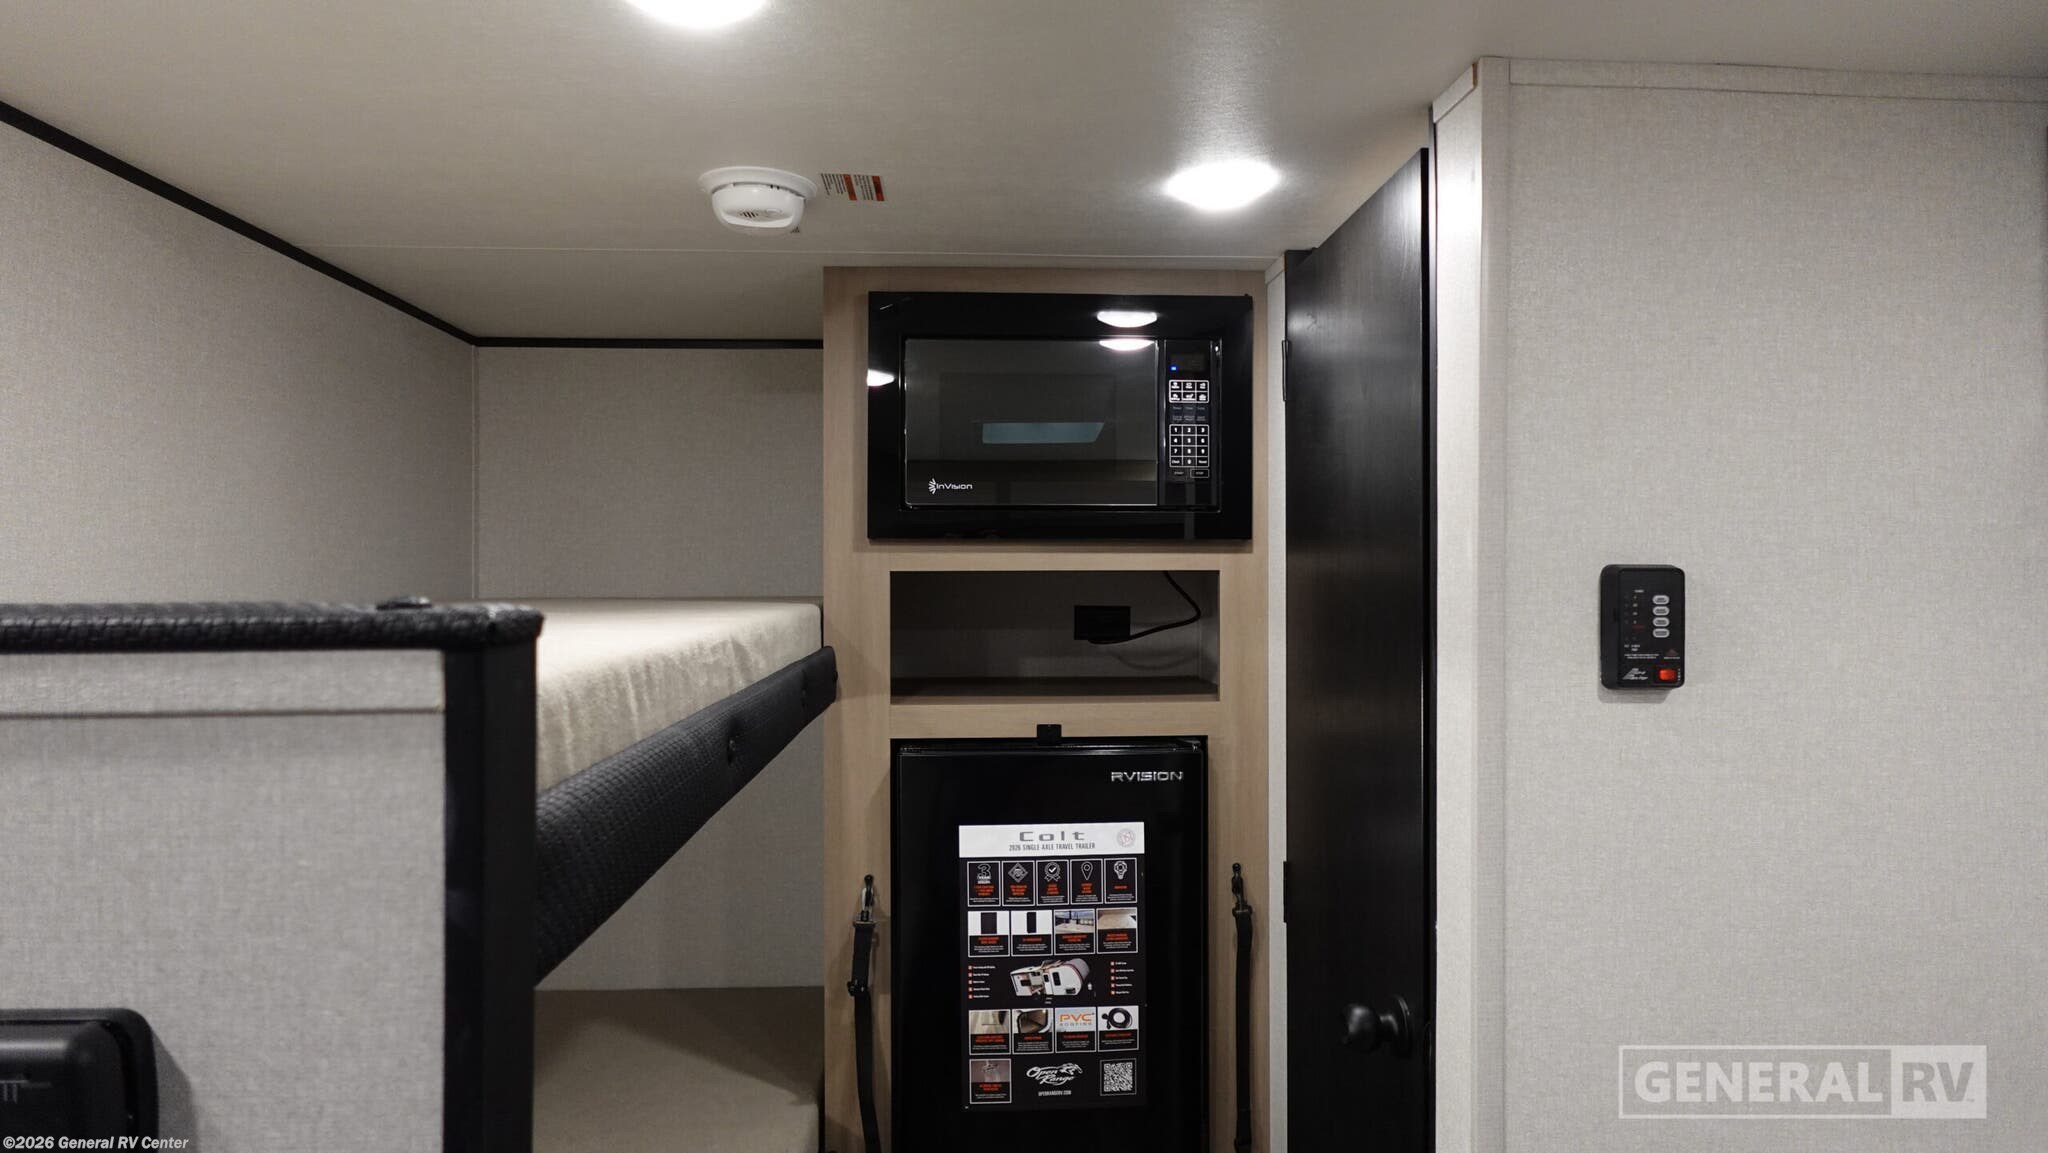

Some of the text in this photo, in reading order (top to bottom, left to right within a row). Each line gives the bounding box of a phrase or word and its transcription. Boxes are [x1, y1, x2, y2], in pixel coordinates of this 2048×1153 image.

[1111, 771, 1184, 782] RVISION
[1019, 831, 1085, 843] Colt
[1060, 1013, 1092, 1022] PVC
[1026, 1066, 1058, 1080] Open
[1039, 1074, 1074, 1084] Range
